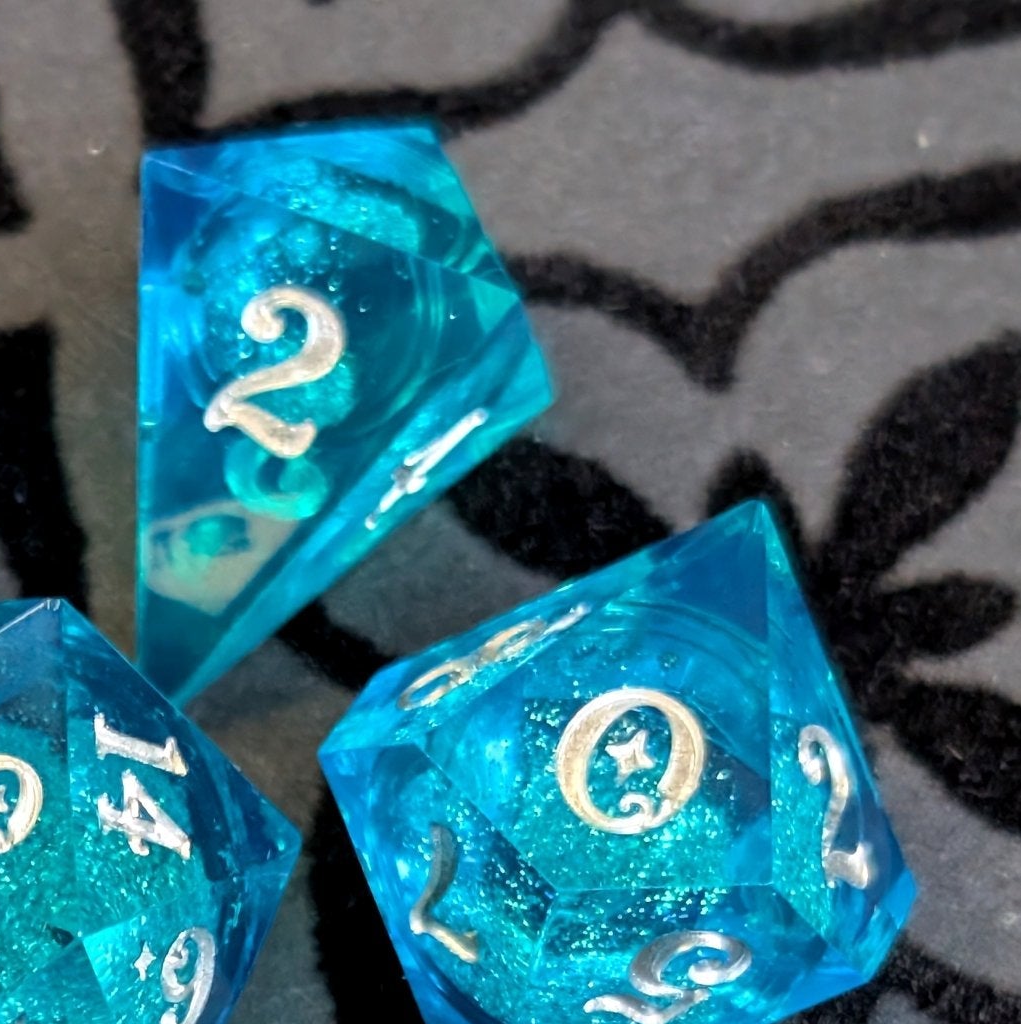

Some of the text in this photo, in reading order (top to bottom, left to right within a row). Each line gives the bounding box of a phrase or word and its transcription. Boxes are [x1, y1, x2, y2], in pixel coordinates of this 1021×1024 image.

[203, 284, 346, 459] 2
[93, 711, 193, 861] 14
[555, 687, 705, 836] 0
[797, 724, 872, 890] 2
